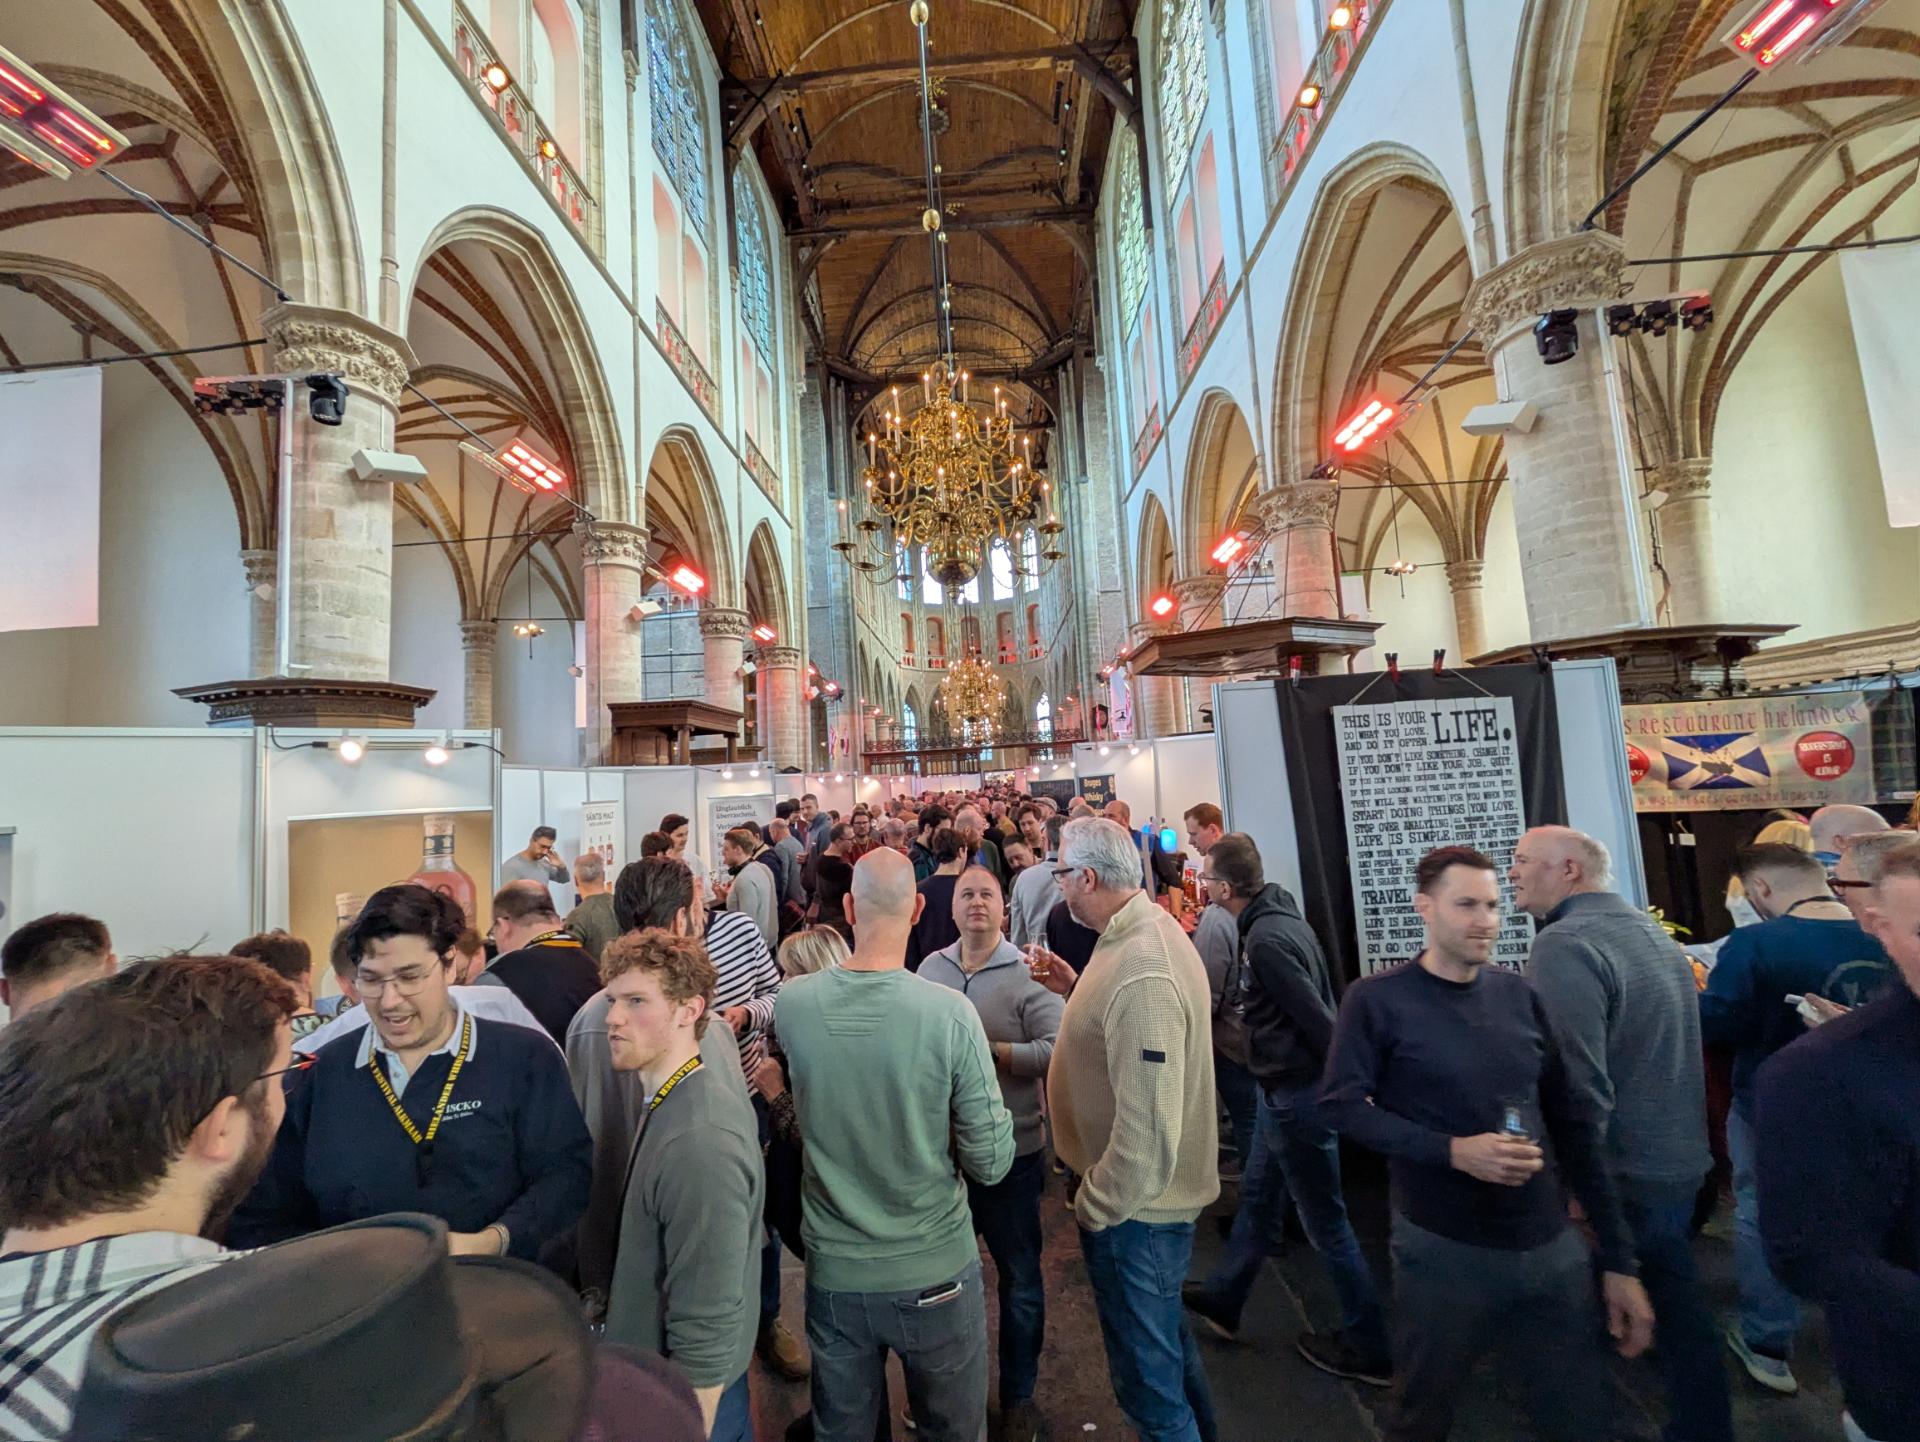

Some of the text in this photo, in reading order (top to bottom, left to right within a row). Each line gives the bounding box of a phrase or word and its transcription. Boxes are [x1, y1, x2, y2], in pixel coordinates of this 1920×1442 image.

[1342, 711, 1426, 728] THIS IS YOUR
[1431, 709, 1512, 744] LIFE.
[1344, 727, 1429, 740] DO WHAT YOU LOVE.
[1345, 738, 1431, 751] AND DO IT OFTEN.
[1347, 756, 1356, 765] IF
[1359, 755, 1373, 764] YOU
[1377, 752, 1400, 763] DON'T
[1405, 752, 1423, 761] LIKE
[1473, 747, 1498, 757] CHANGE
[1348, 767, 1358, 775] IF
[1363, 765, 1379, 774] YOU
[1384, 763, 1411, 773] DON'T
[1416, 761, 1438, 771] LIKE
[1442, 760, 1463, 769] YOUR
[1490, 757, 1514, 767] QUIT.
[1351, 790, 1516, 808] THEY WILL BE WAITING FOR YOU WHEN YOU
[1353, 801, 1518, 821] START DOING THINGS YOU LOVE.
[1354, 823, 1375, 834] STOP
[1379, 822, 1399, 832] OVER
[1404, 818, 1453, 830] ANALYZING.
[1355, 830, 1454, 847] LIFE IS SIMPLE.
[1455, 831, 1477, 840] EVERY
[1481, 829, 1498, 838] LAST
[1378, 877, 1400, 886] SHARE
[1361, 888, 1411, 905] TRAVEL
[1365, 918, 1384, 928] LIFE
[1389, 917, 1398, 927] IS
[1366, 930, 1384, 940] THE
[1388, 928, 1424, 939] THINGS
[1367, 943, 1380, 954] SO
[1386, 943, 1399, 953] GO
[1405, 941, 1423, 952] OUT
[1497, 943, 1528, 955] DREAM
